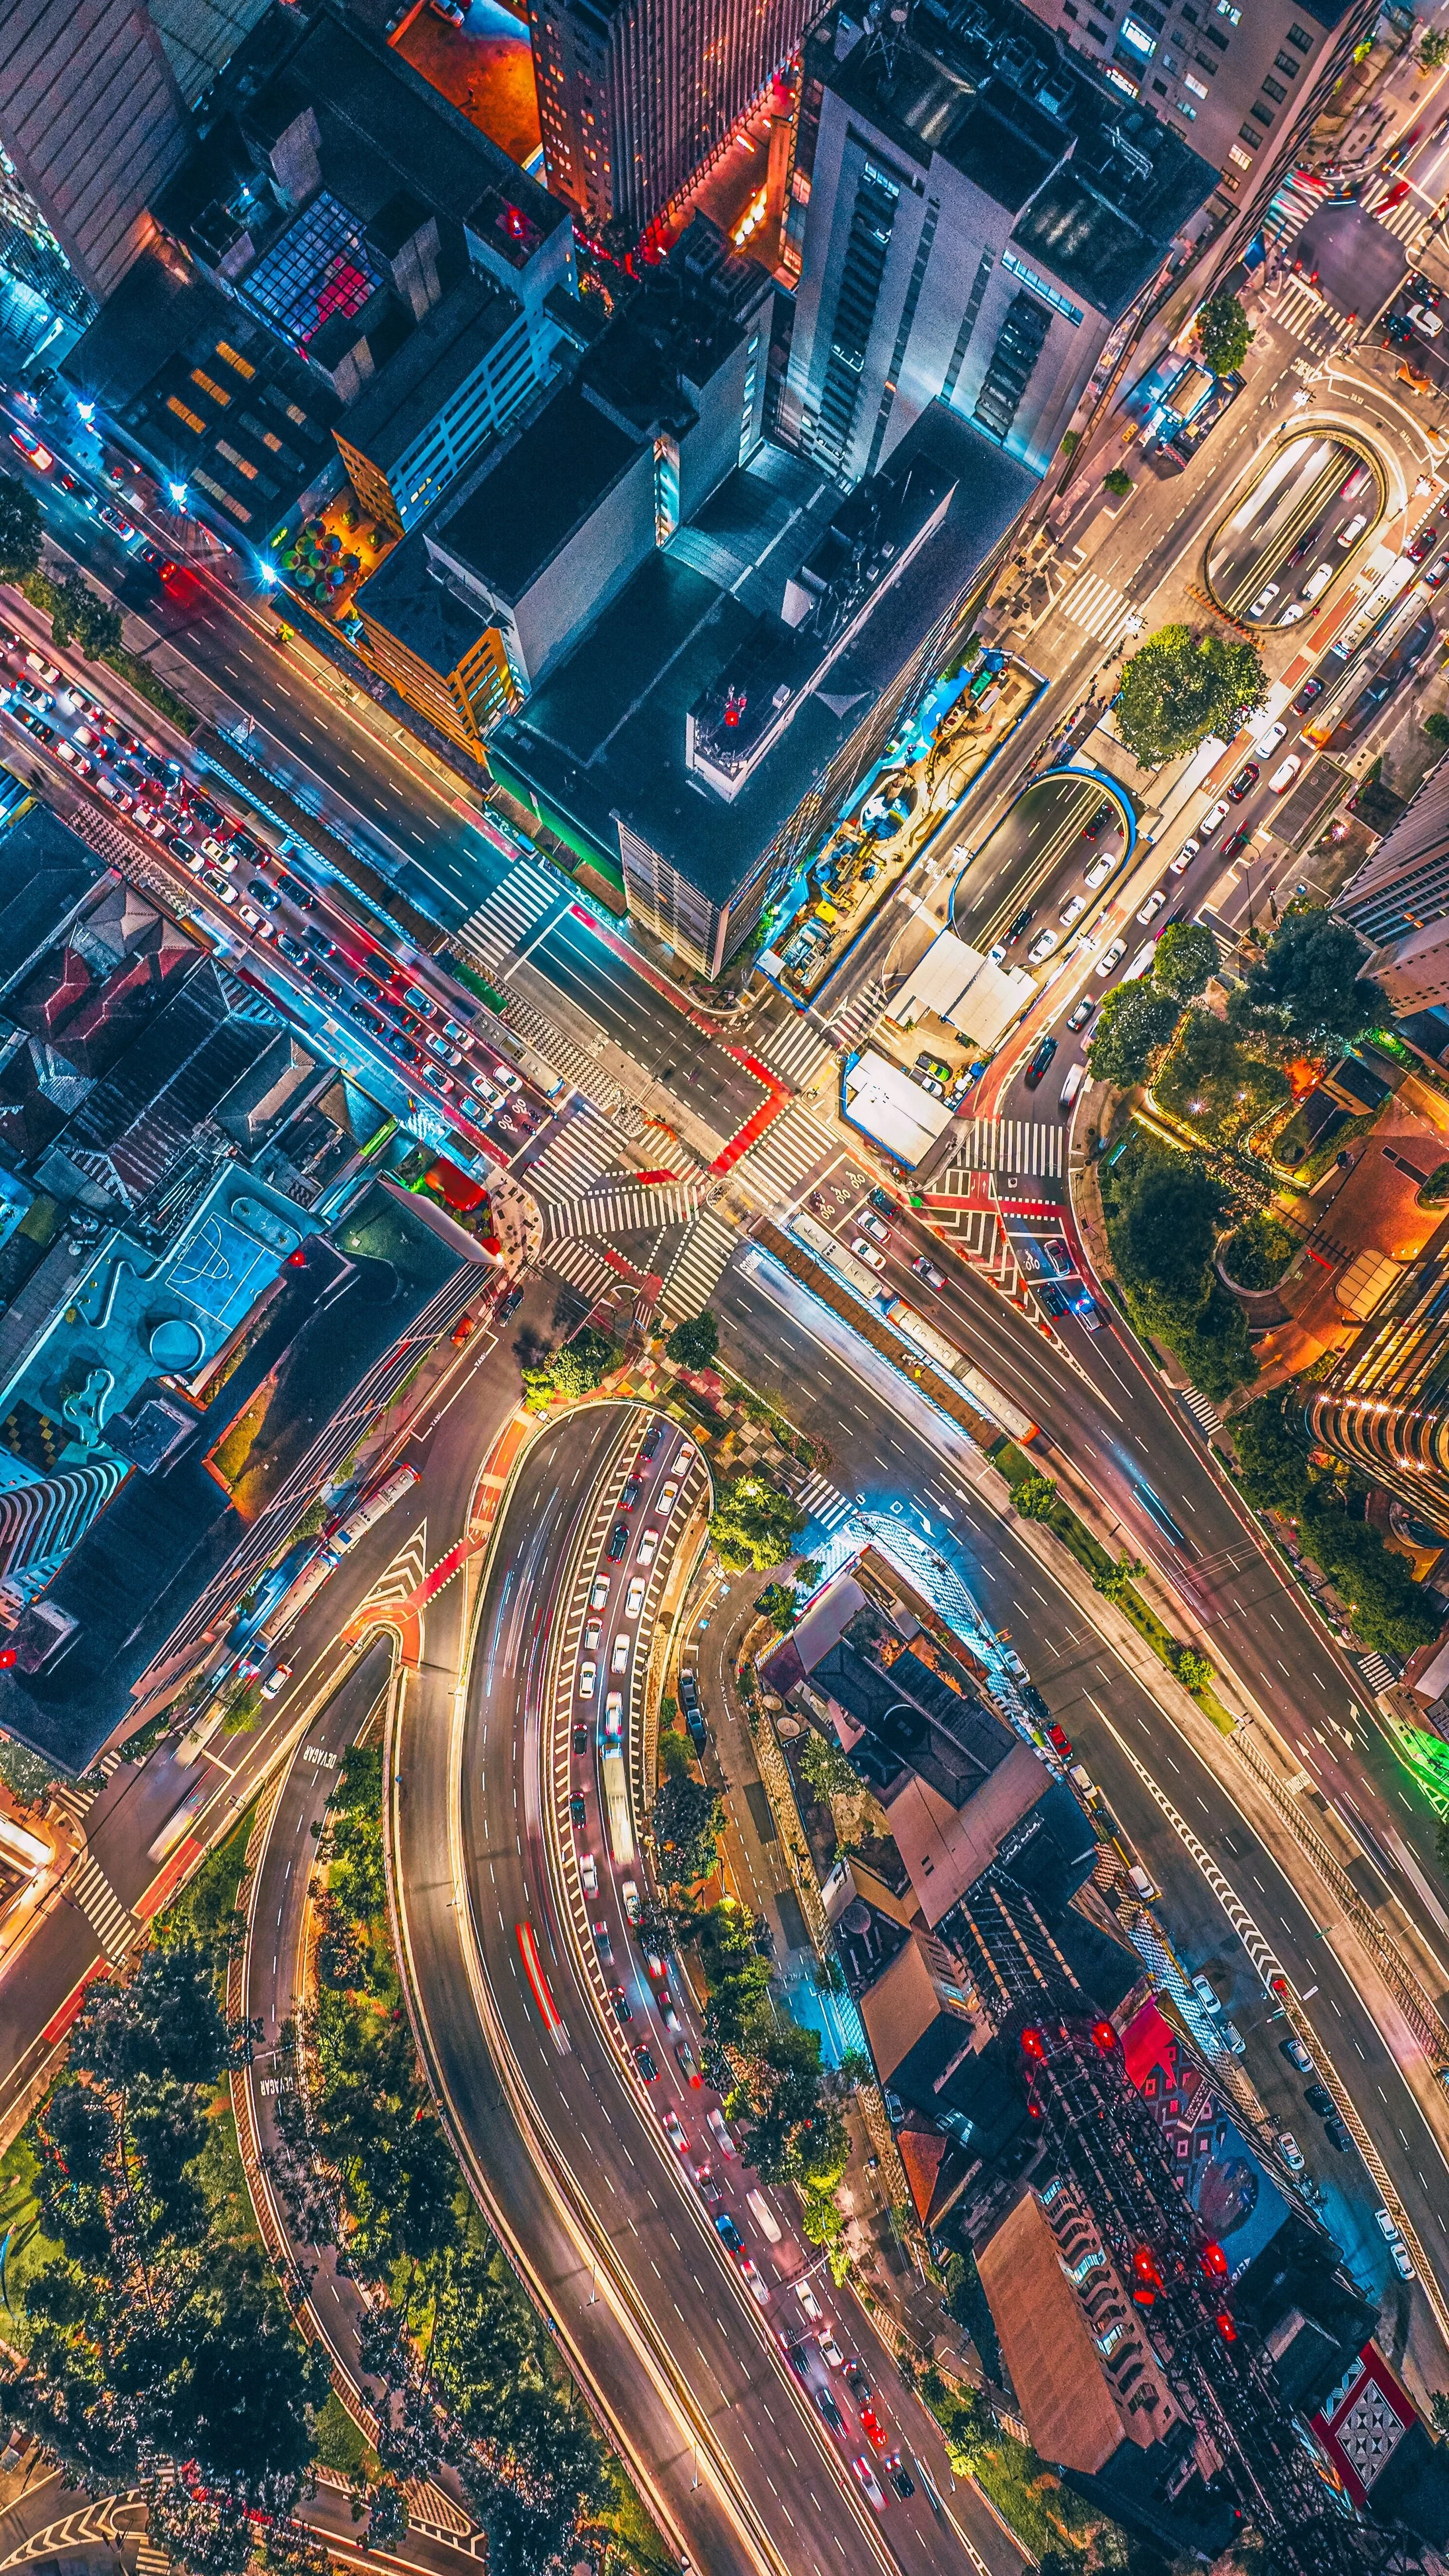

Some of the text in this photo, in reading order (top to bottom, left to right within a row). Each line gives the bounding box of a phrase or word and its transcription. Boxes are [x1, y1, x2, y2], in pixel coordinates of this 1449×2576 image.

[1350, 393, 1364, 405] TAXI
[1399, 430, 1412, 444] TAXI
[740, 1249, 767, 1275] ÔNIBUS
[871, 1282, 880, 1292] 2763
[474, 1352, 486, 1367] TAXI
[429, 1411, 442, 1427] TAXI
[736, 1603, 749, 1622] TAXI
[303, 1744, 337, 1769] DEVAGAR
[1281, 1770, 1311, 1796] ÔNIBUS
[260, 2076, 294, 2096] DEVAGAR
